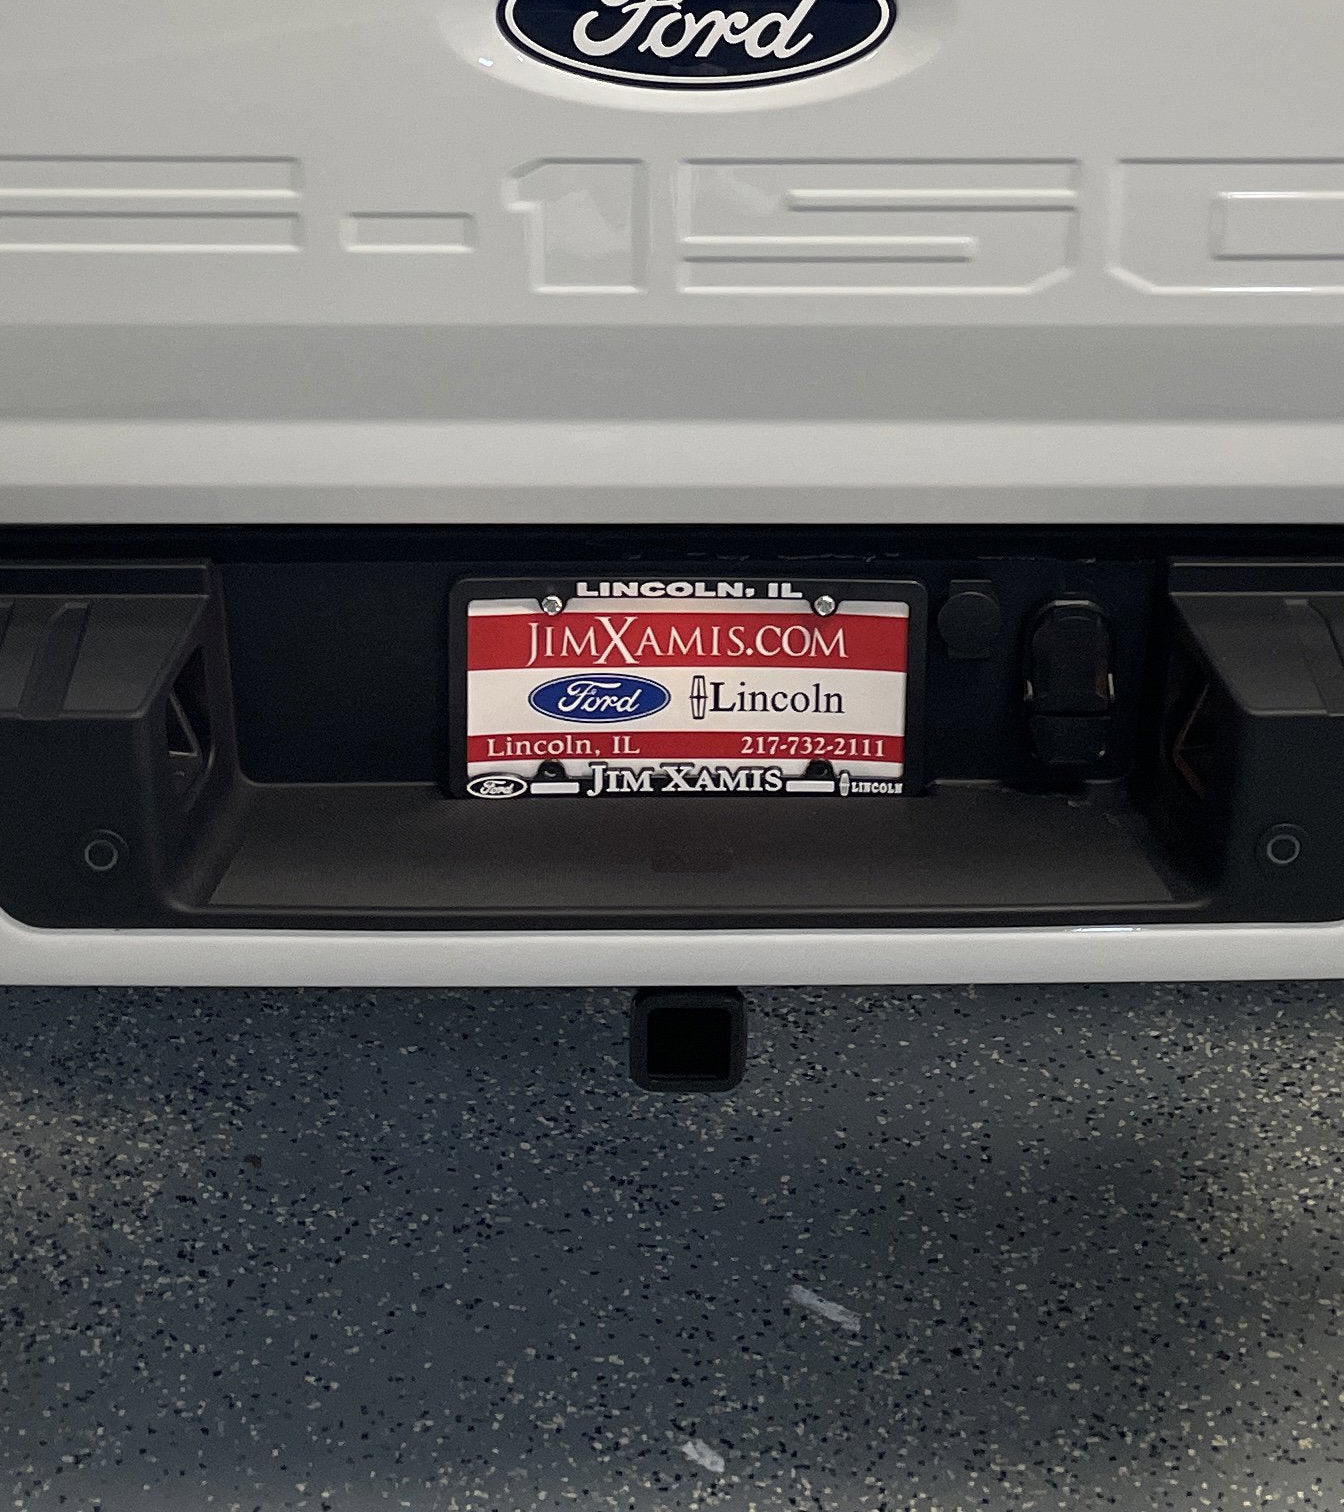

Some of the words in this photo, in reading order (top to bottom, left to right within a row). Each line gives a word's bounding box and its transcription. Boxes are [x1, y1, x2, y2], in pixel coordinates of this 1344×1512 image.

[576, 582, 756, 598] LINCOLN,
[768, 582, 803, 599] IL
[526, 616, 849, 667] JIMXAMIS.COM
[557, 679, 642, 714] Ford
[709, 682, 845, 714] Lincoln
[487, 735, 601, 758] Lincoln,
[613, 735, 641, 755] IL
[740, 736, 885, 757] 217-732-2111
[587, 765, 654, 796] JIM
[661, 766, 783, 792] XAMIS
[850, 781, 904, 794] LINCOLN
